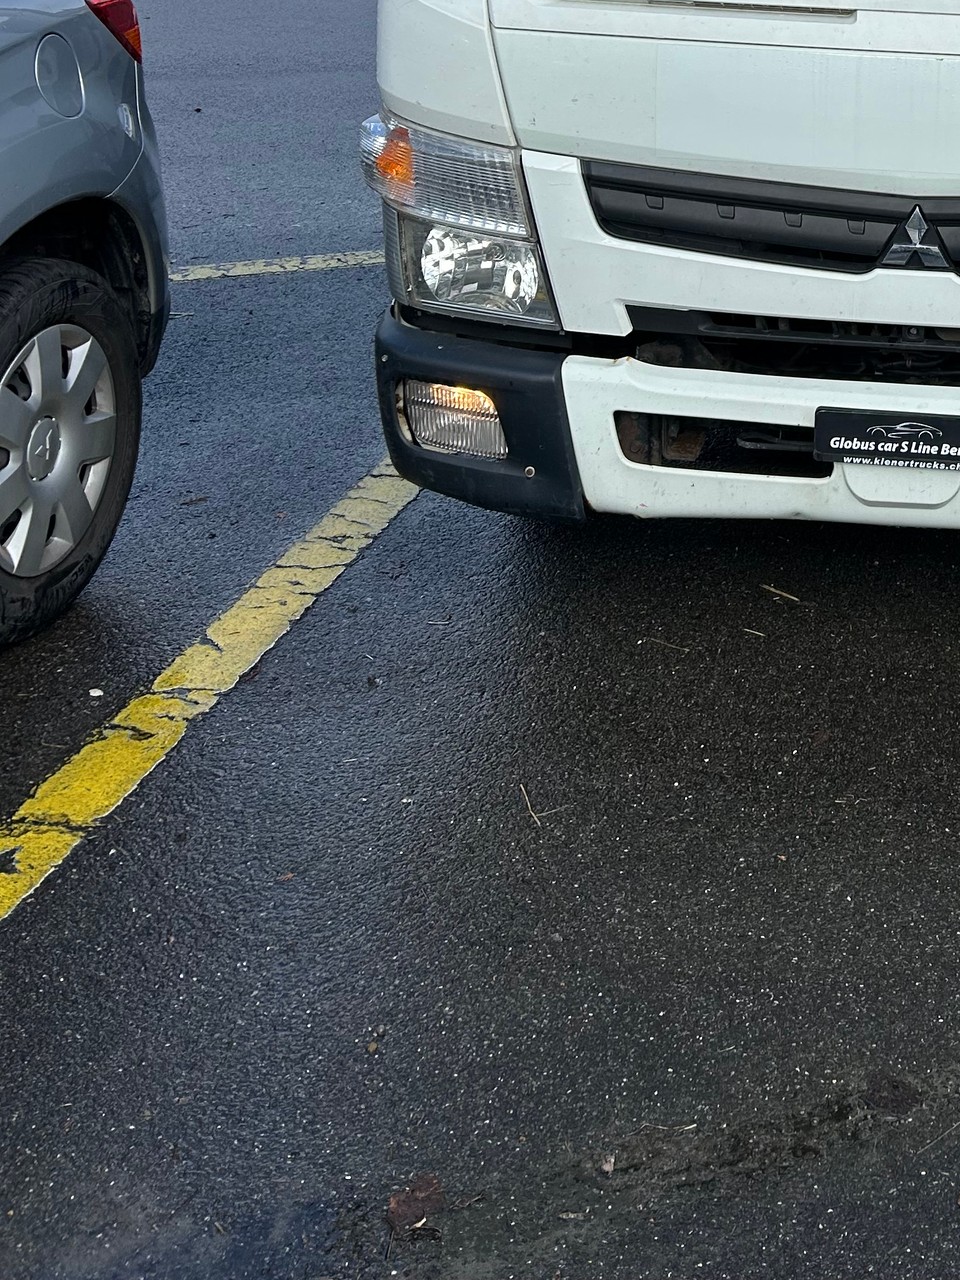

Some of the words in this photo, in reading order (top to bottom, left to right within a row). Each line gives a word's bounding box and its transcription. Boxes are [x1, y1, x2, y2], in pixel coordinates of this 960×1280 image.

[829, 436, 876, 451] Globus
[877, 441, 898, 452] car
[899, 440, 909, 453] S
[910, 441, 938, 455] Line
